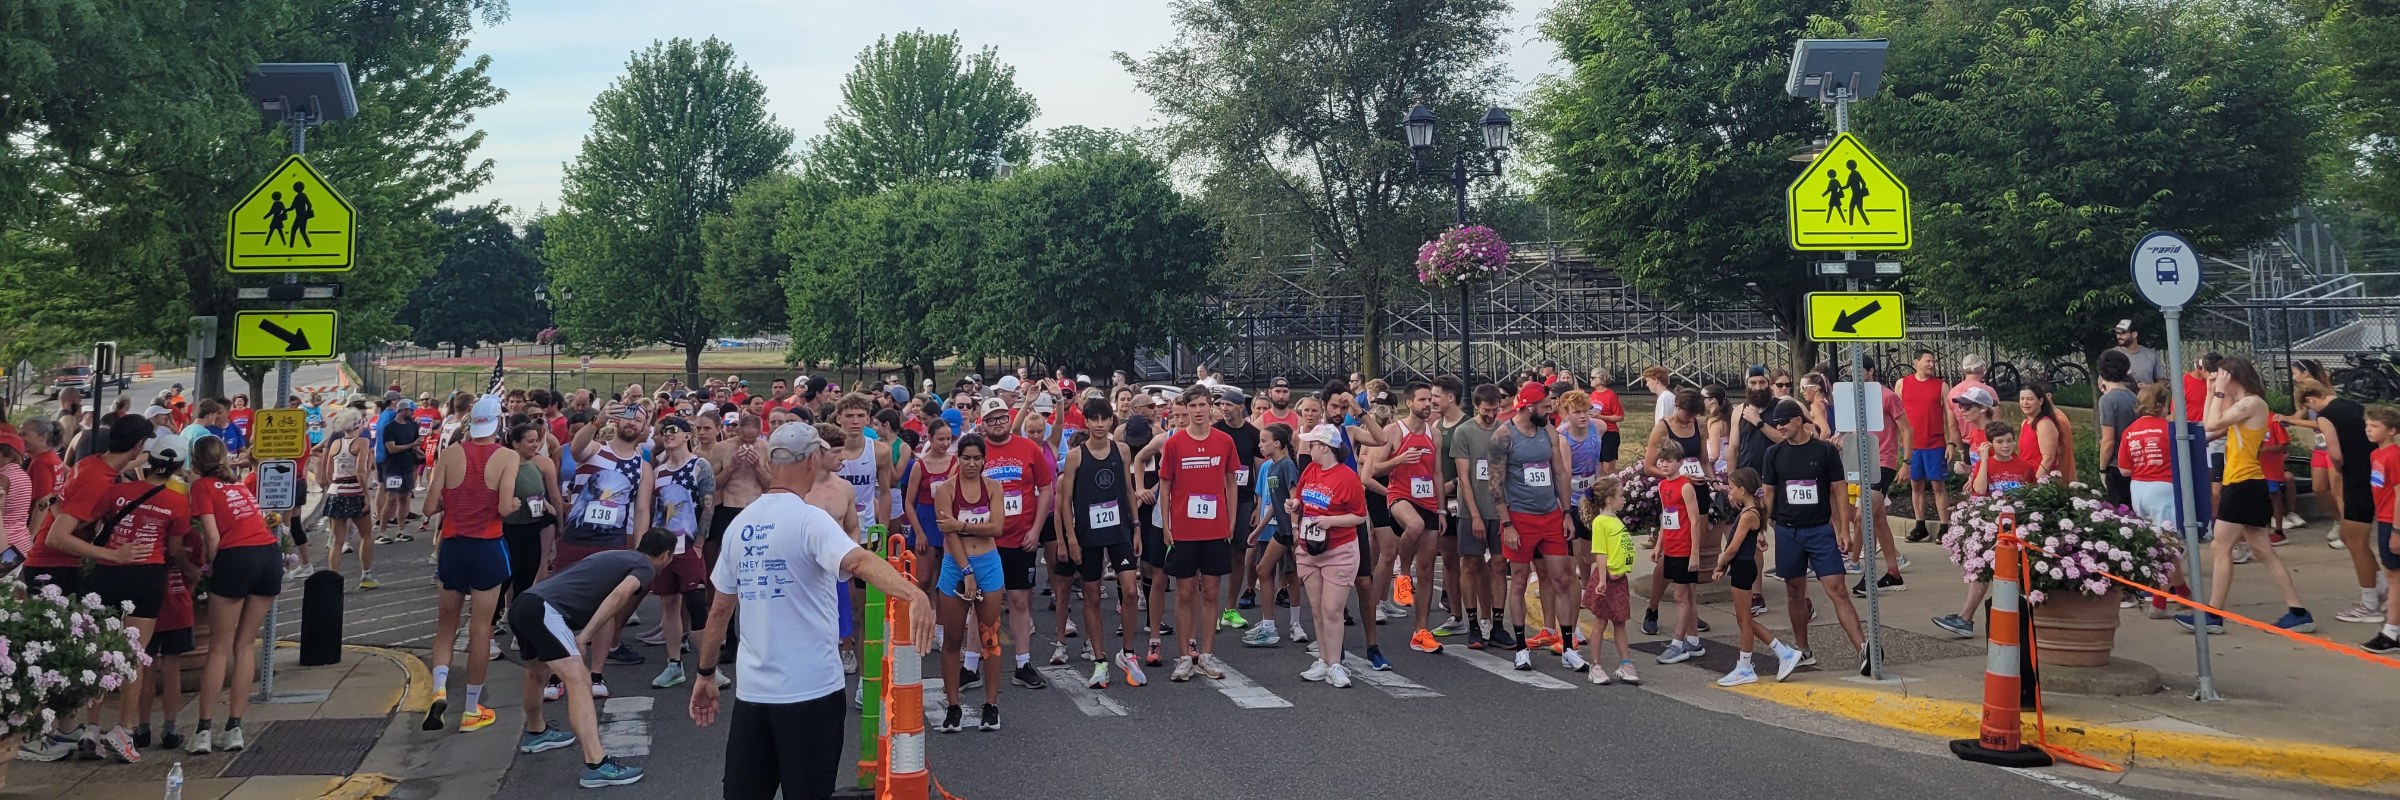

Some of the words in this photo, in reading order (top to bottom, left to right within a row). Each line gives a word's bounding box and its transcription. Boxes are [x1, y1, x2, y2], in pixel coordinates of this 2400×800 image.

[1529, 471, 1546, 483] 359
[1416, 483, 1431, 494] 242
[1792, 489, 1812, 500] 796
[1196, 503, 1209, 514] 19
[591, 508, 611, 521] 138
[1095, 510, 1115, 523] 120
[1304, 525, 1320, 536] 145
